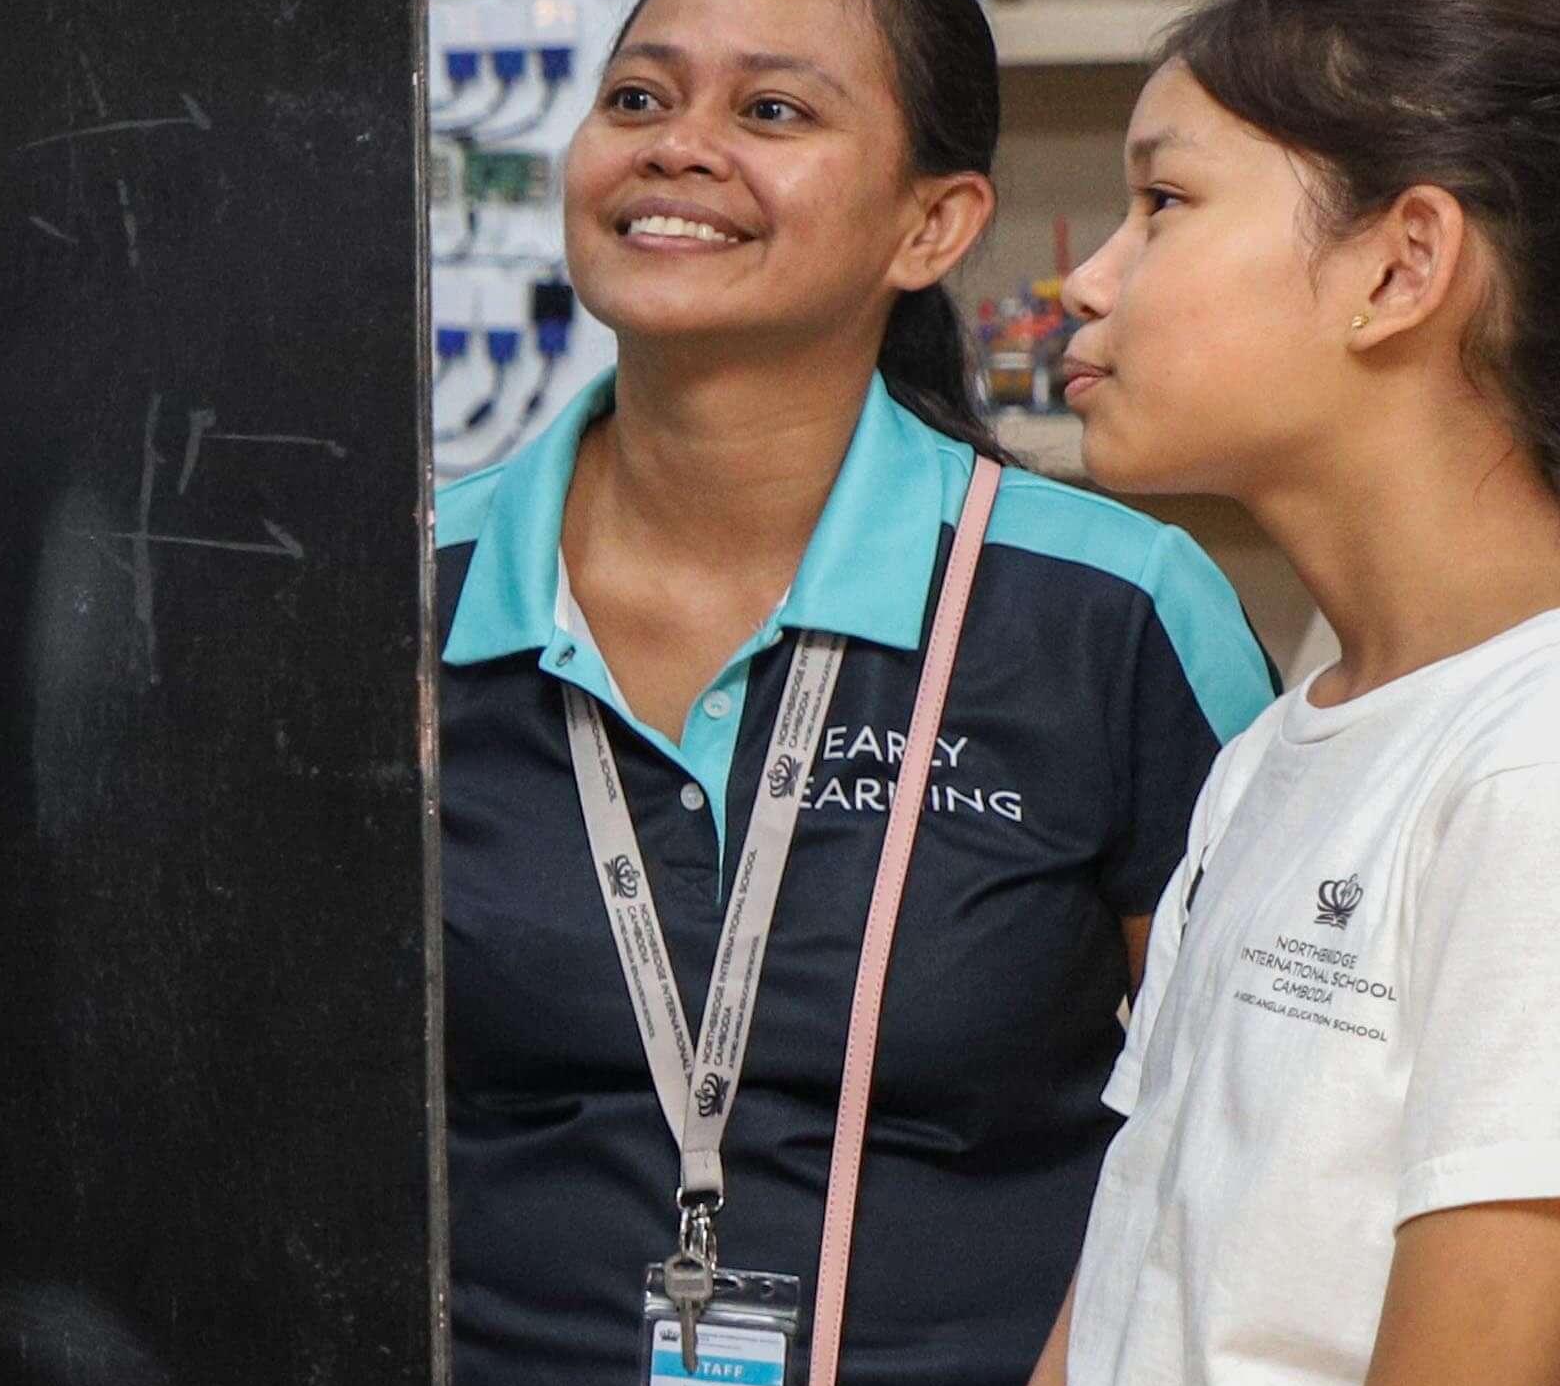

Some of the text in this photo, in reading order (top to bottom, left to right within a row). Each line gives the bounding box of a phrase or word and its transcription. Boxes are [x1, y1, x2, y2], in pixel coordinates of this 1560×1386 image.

[823, 724, 968, 769] EARY
[1240, 947, 1397, 1001] INTERNATIONAL SCHOOL
[1272, 978, 1333, 1005] CAMBODIA
[1333, 1019, 1387, 1042] SCHOOL
[696, 1360, 745, 1378] TAFF
